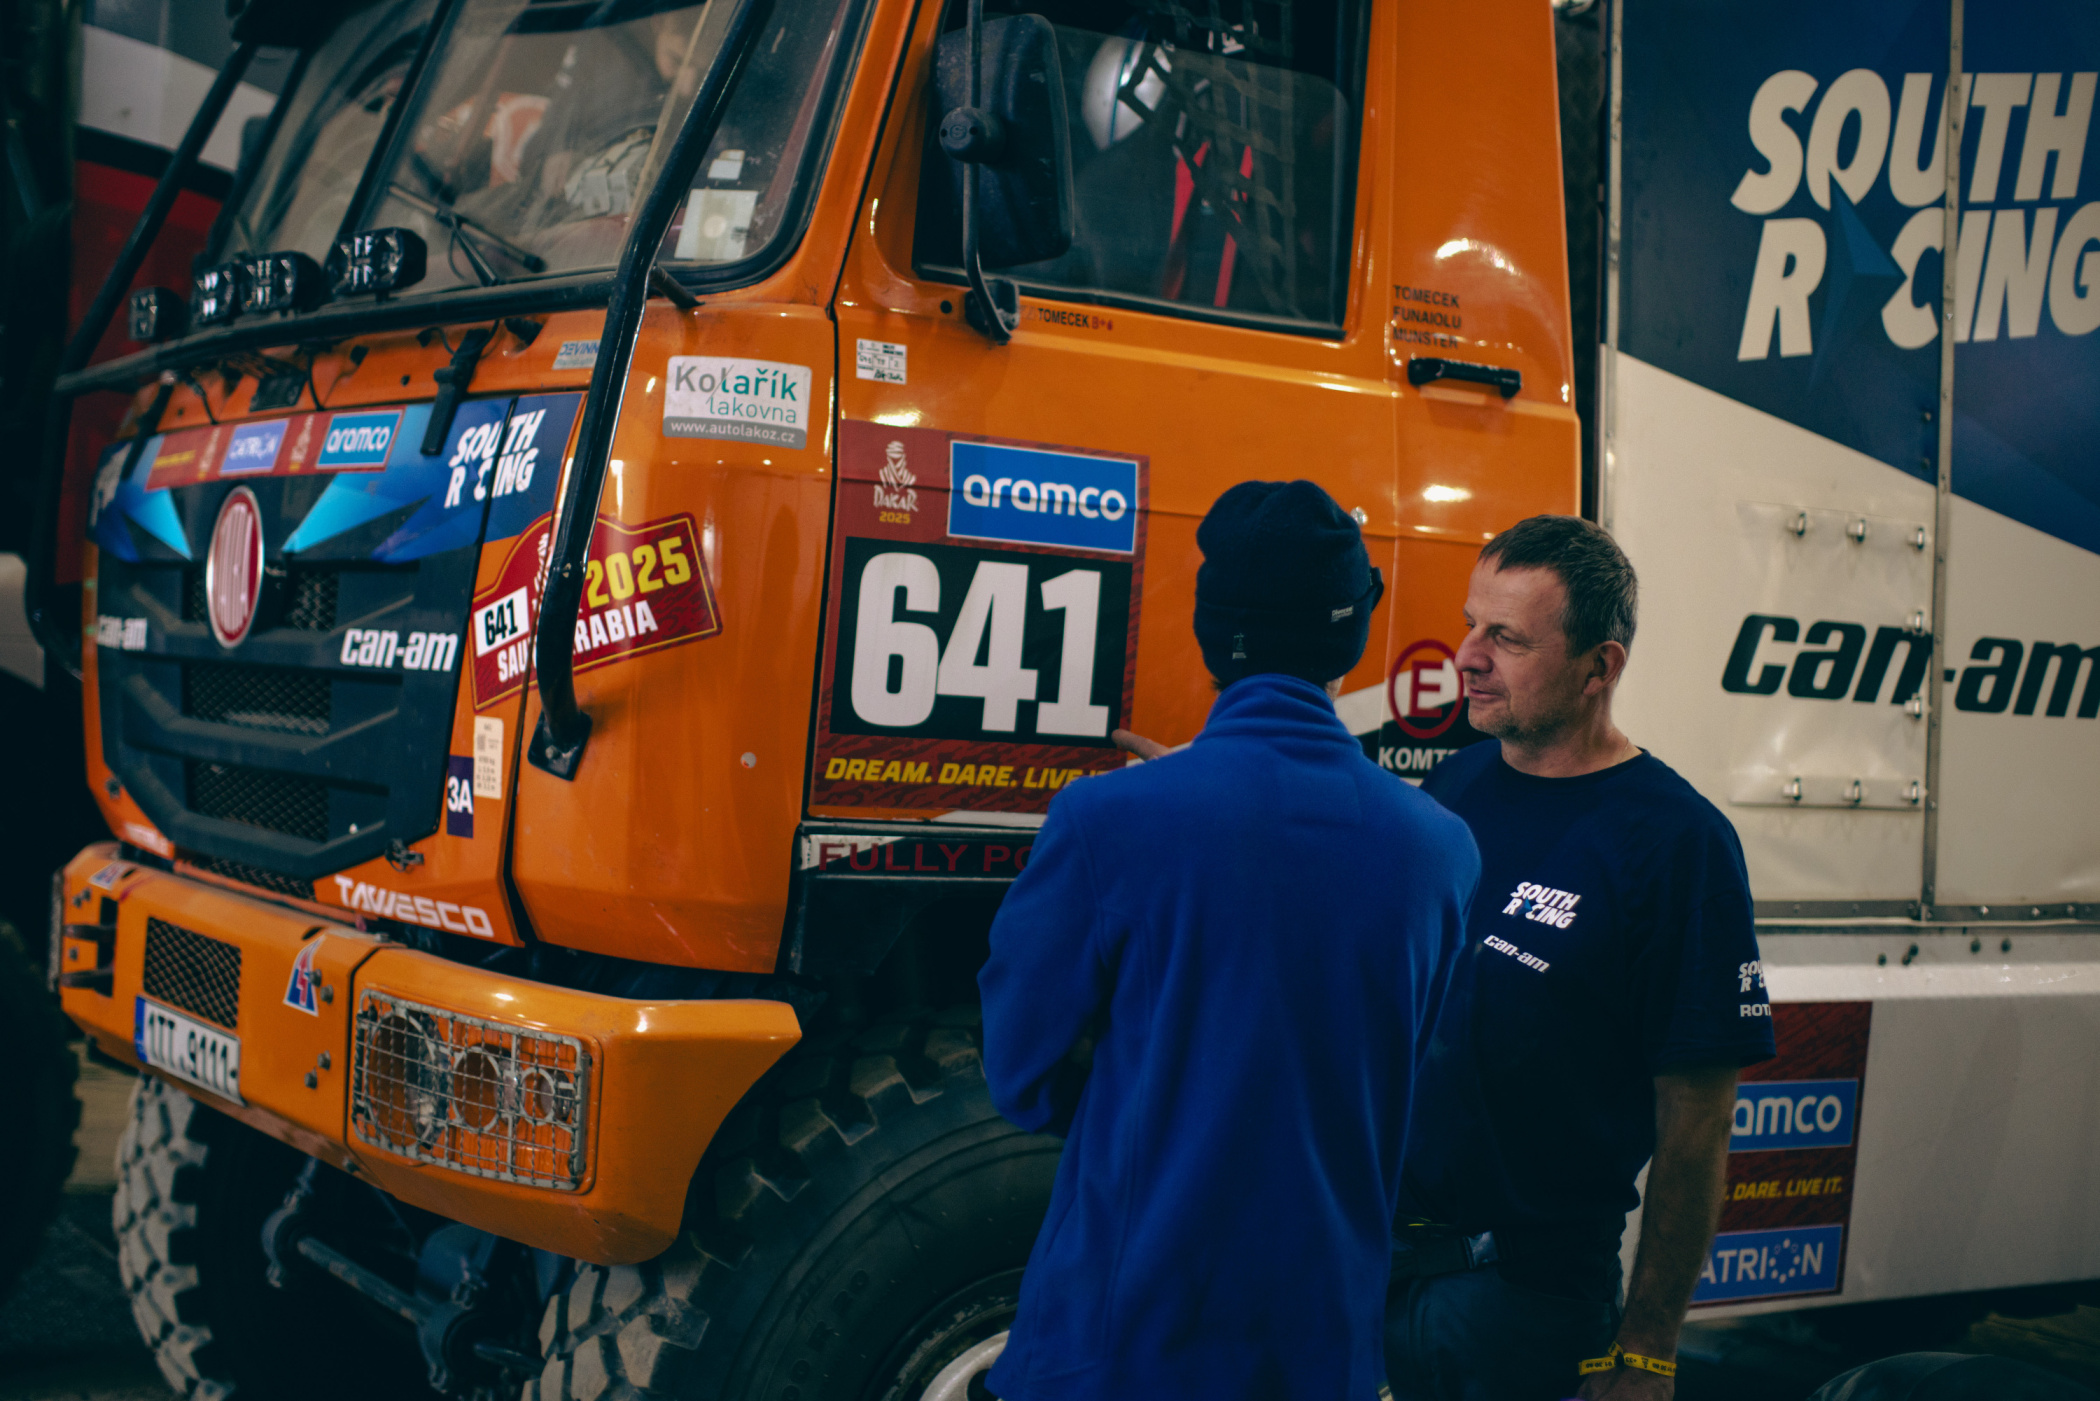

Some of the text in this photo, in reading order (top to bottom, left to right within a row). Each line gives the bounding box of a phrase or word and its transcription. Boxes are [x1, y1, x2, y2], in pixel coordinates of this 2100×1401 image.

[1730, 68, 2099, 215] SOUTH
[1393, 284, 1459, 308] TOMECEK
[1038, 308, 1089, 328] TOMECEK
[675, 365, 797, 401] Kolařík
[710, 397, 797, 423] lakovna
[326, 426, 390, 454] aramco
[448, 409, 546, 468] SOUTH
[671, 421, 795, 443] www.autolakoz.cz
[873, 485, 918, 512] DAKAR
[963, 474, 1127, 521] aramco
[879, 511, 911, 524] 2025
[586, 536, 691, 608] 2025
[484, 598, 518, 646] 641
[341, 628, 458, 672] can-am
[851, 552, 1109, 737] 641
[1720, 612, 2100, 720] can-am
[824, 758, 931, 784] DREAM.
[938, 763, 1016, 787] DARE.
[1379, 747, 1460, 770] KOMT
[447, 776, 474, 814] 3A
[819, 842, 968, 871] FULLY
[1510, 881, 1581, 910] SOUTH
[1483, 934, 1550, 973] can-am
[1734, 1180, 1781, 1200] DARE.
[1785, 1177, 1823, 1197] LIVE
[1824, 1176, 1842, 1194] IT.
